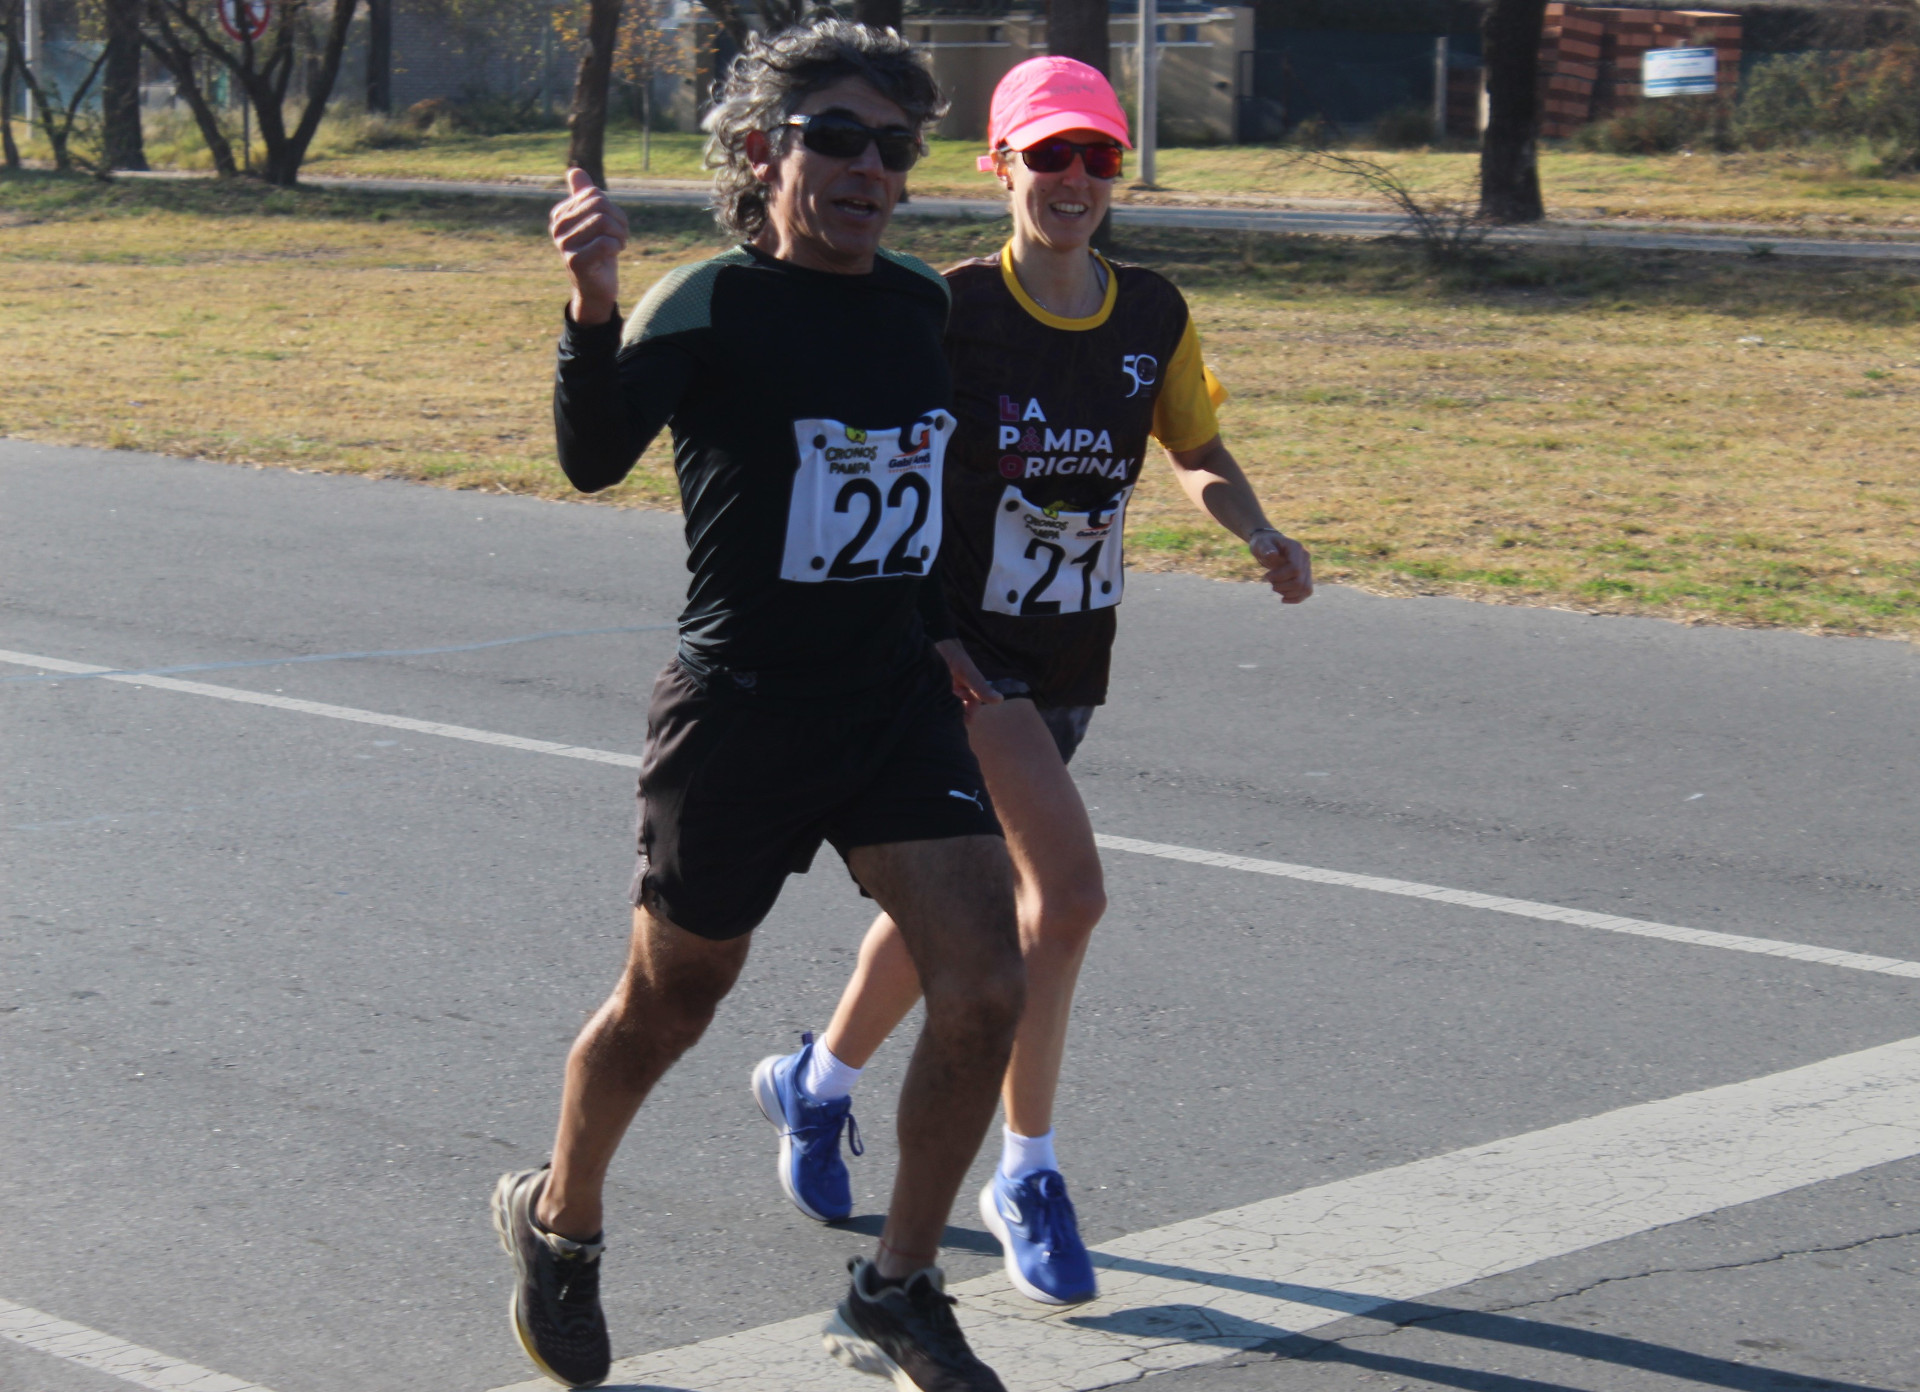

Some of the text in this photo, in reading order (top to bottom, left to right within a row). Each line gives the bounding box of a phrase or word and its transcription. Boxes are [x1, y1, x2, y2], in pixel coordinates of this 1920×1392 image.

[999, 395, 1047, 423] LA
[825, 446, 878, 461] CRONOS
[998, 425, 1113, 454] PAMPA
[829, 462, 871, 475] PAMPA
[827, 471, 932, 579] 22
[1024, 513, 1069, 531] CRONOS
[1020, 538, 1105, 617] 21
